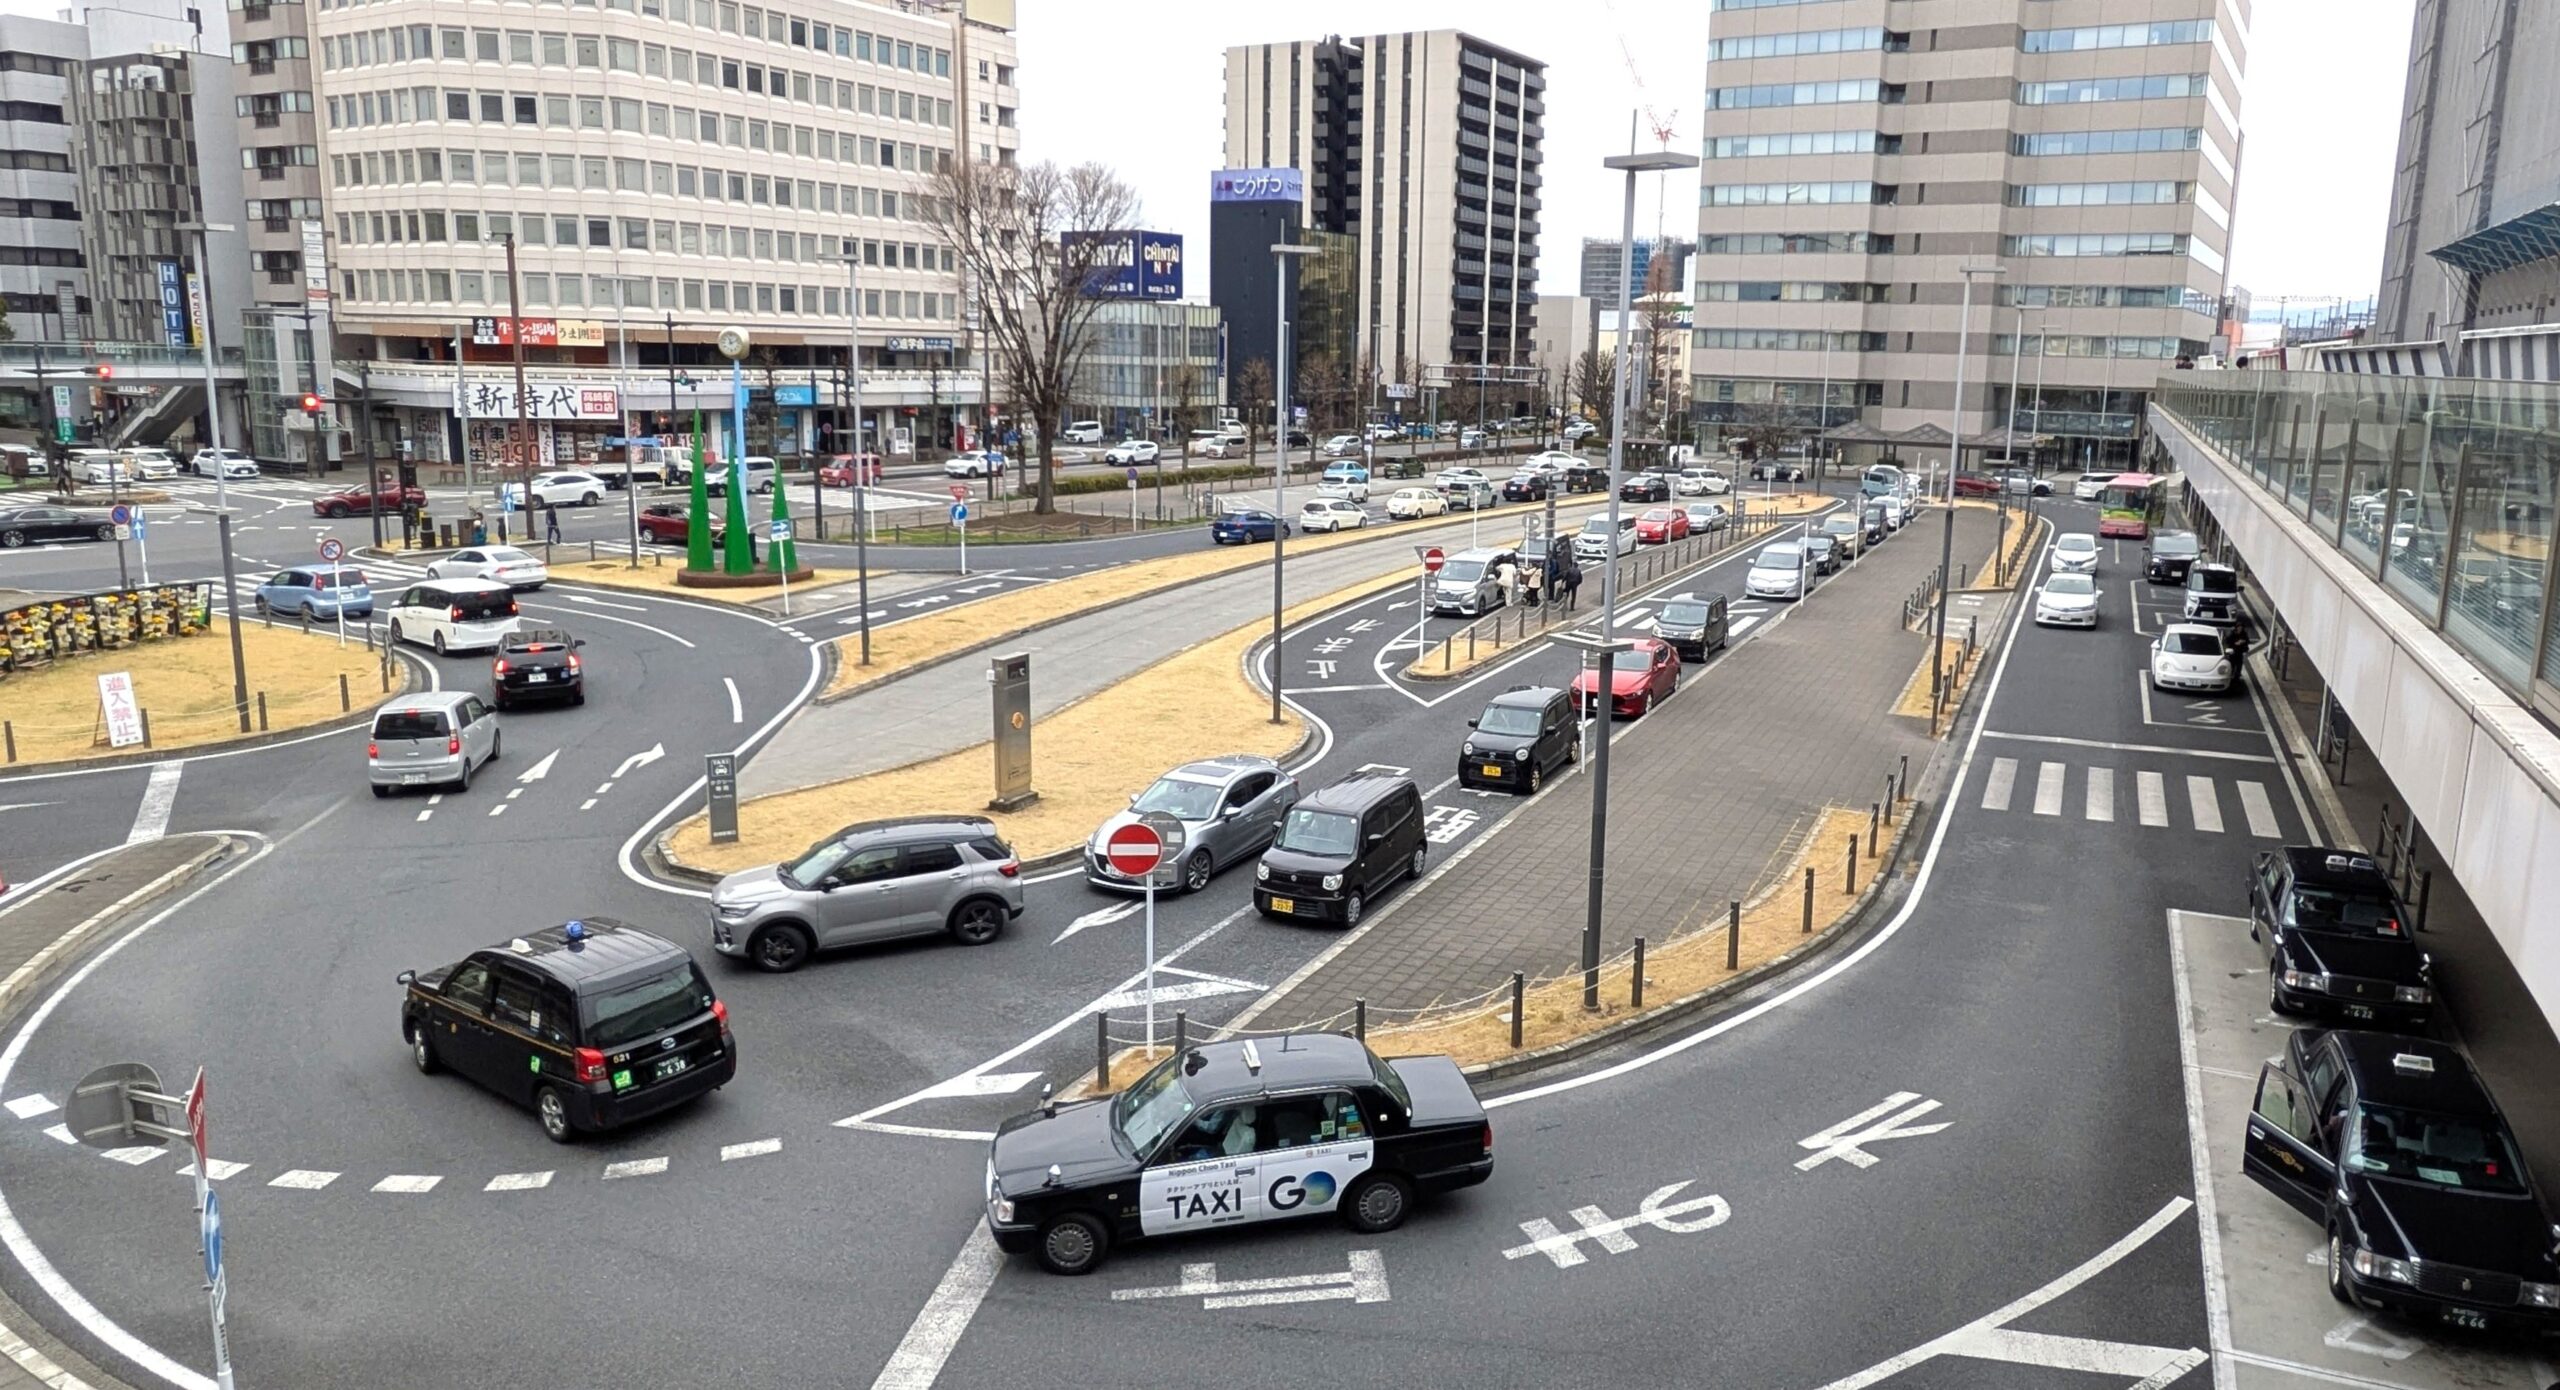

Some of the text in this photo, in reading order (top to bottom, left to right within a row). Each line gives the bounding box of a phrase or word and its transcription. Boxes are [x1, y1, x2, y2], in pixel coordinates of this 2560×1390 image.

[1234, 173, 1283, 197] こうげつ
[1144, 241, 1180, 263] CHINTAI
[473, 383, 579, 418] 新時代
[105, 676, 138, 737] 進入禁止
[1168, 1161, 1237, 1178] Nippon Chuo Taxi
[1166, 1169, 1338, 1219] TAXI GO
